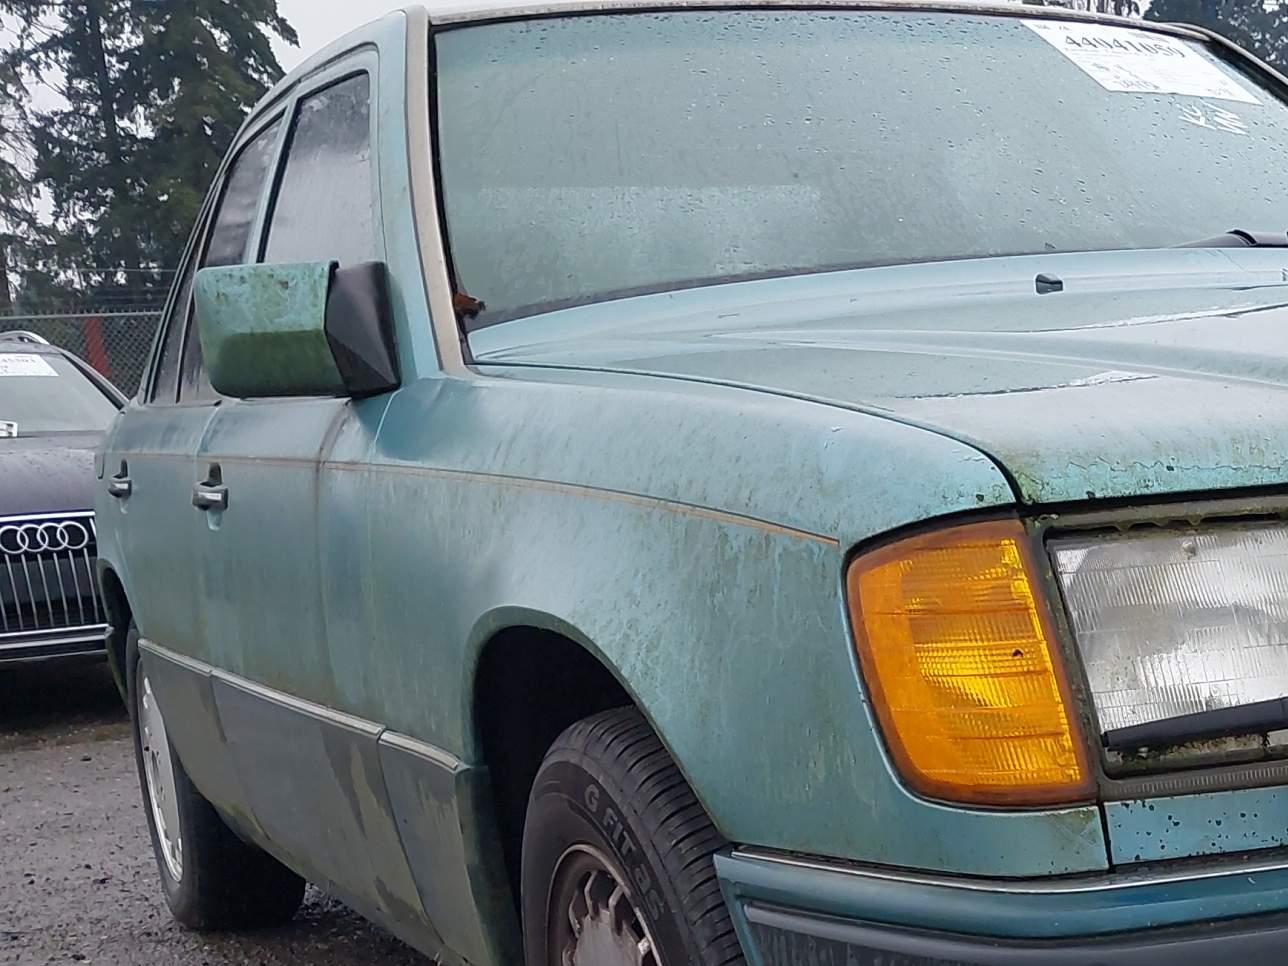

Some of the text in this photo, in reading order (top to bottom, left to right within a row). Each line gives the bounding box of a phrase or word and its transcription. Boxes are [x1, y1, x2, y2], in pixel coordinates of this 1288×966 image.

[1065, 35, 1186, 58] 44041059
[585, 784, 601, 812] G
[603, 808, 637, 856] FIT
